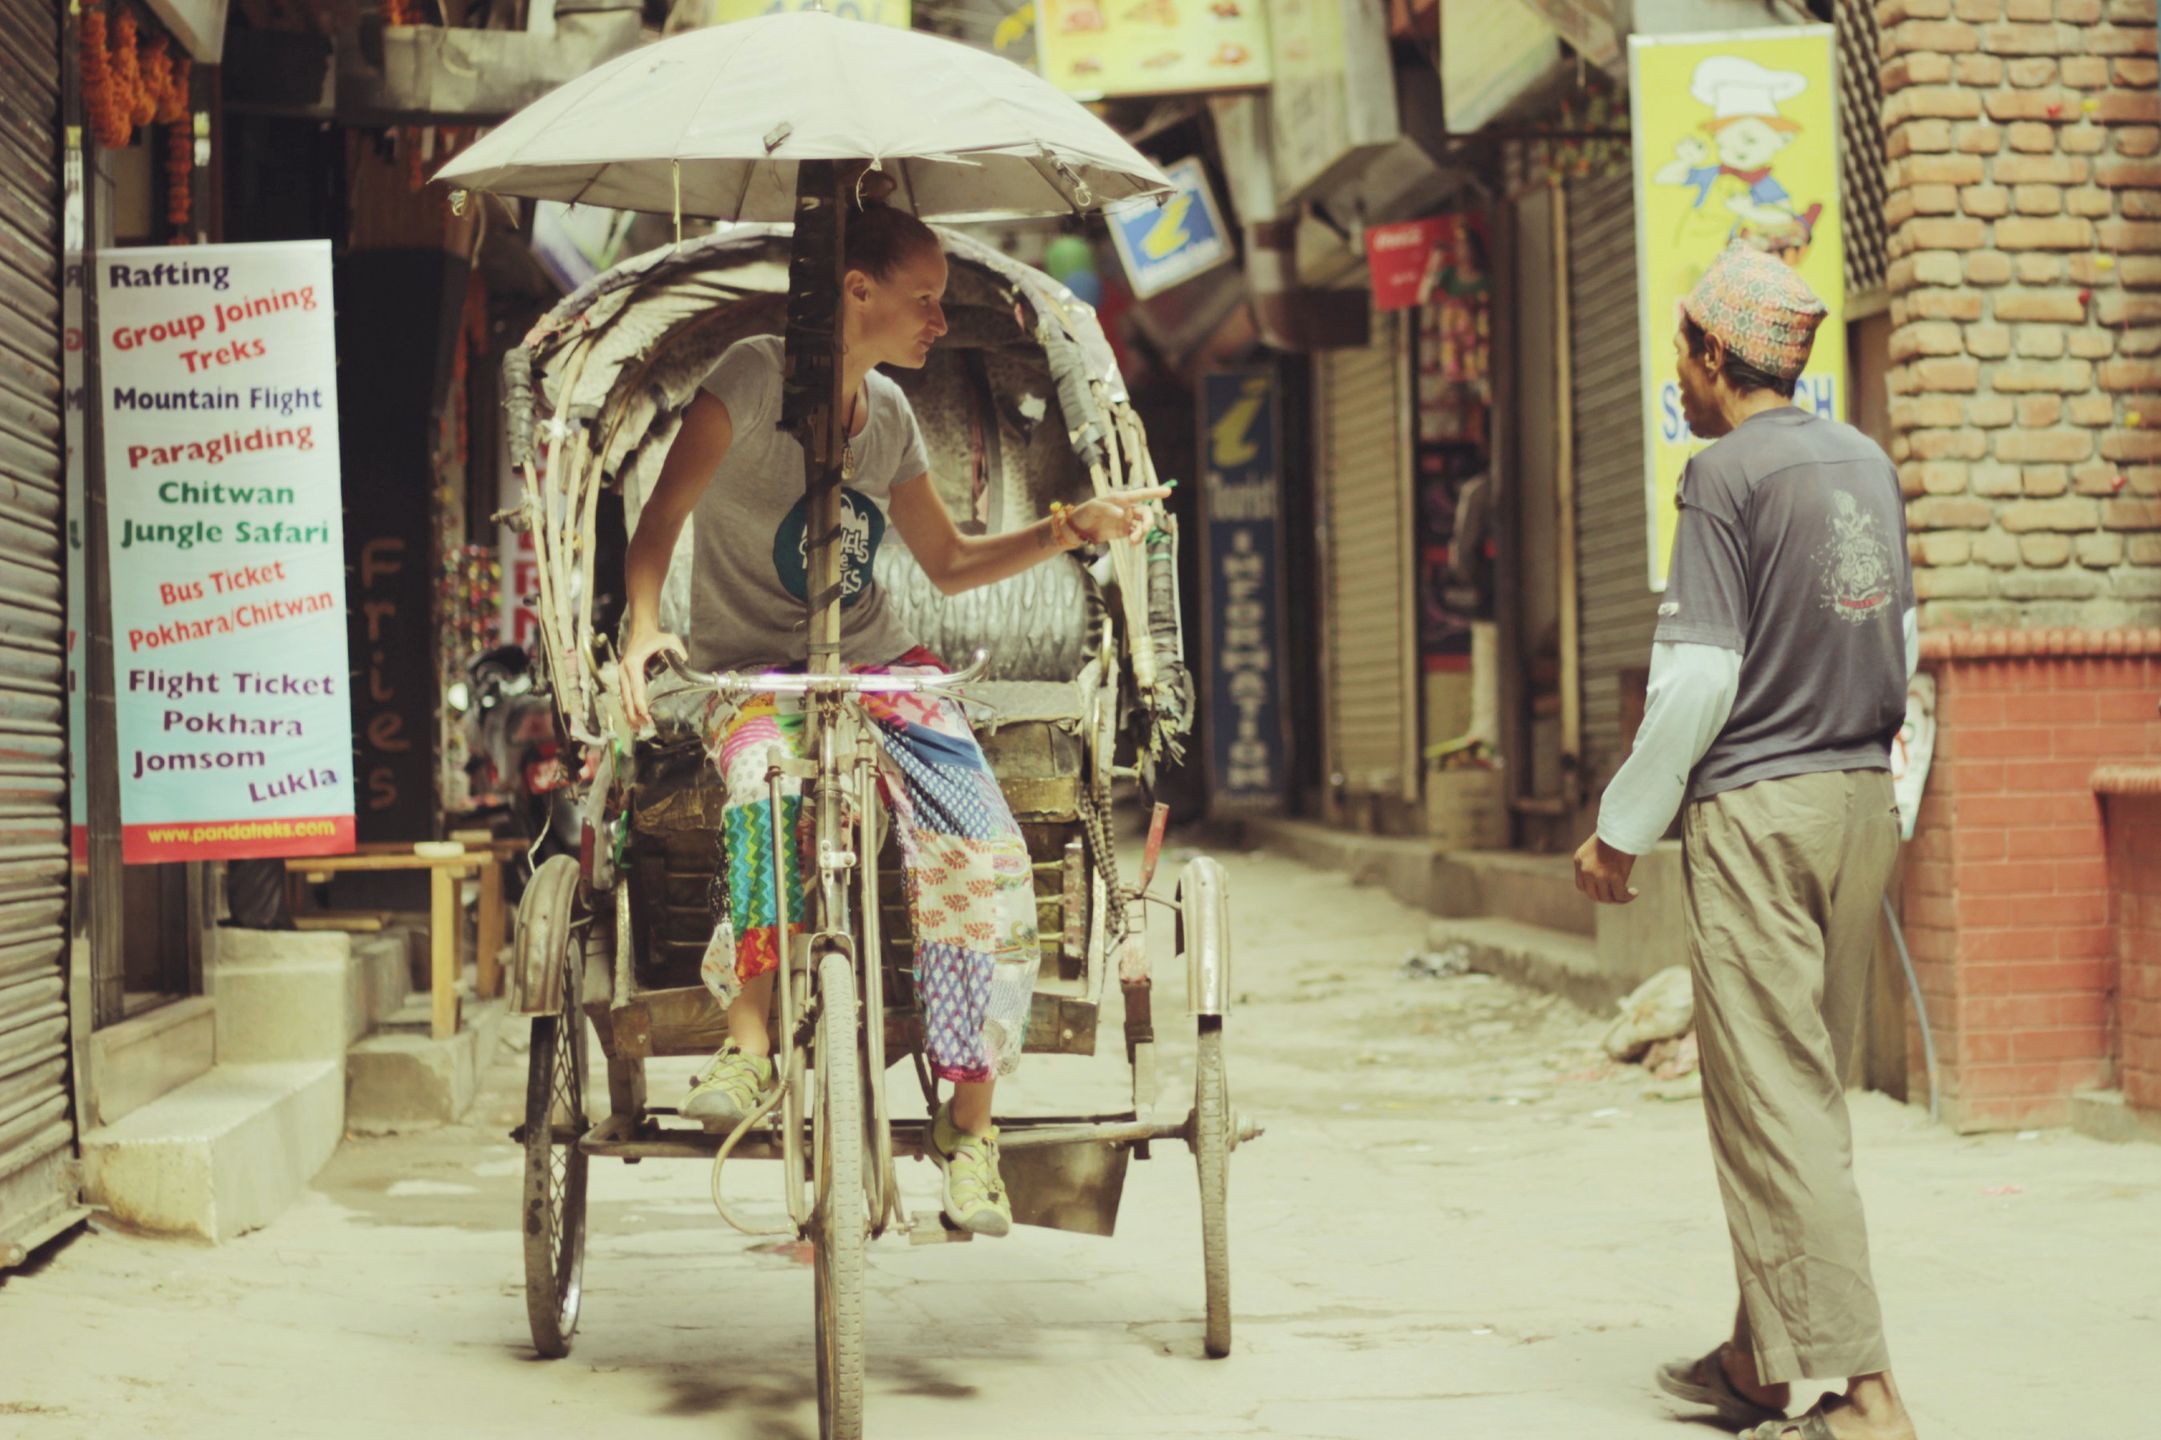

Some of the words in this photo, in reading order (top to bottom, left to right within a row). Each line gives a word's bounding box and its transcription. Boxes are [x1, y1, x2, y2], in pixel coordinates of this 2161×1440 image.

[109, 263, 229, 290] Rafting
[112, 315, 205, 351] Group
[216, 284, 316, 333] Joining
[179, 337, 266, 373] Treks
[113, 387, 239, 410] Mountain
[250, 387, 322, 415] Flight
[128, 425, 313, 470] Paragliding
[158, 481, 294, 505] Chitwan
[120, 519, 222, 549] Jungle
[235, 520, 328, 544] Safari
[160, 581, 203, 606] Bus
[210, 561, 285, 594] Ticket
[128, 589, 333, 653] Pokhara/Chitwan
[129, 669, 219, 699] Flight
[233, 672, 334, 695] Ticket
[163, 710, 303, 736] Pokhara
[133, 750, 265, 779] Jomsom
[248, 768, 338, 803] Lukla
[147, 819, 336, 845] www.pandatreks.com
